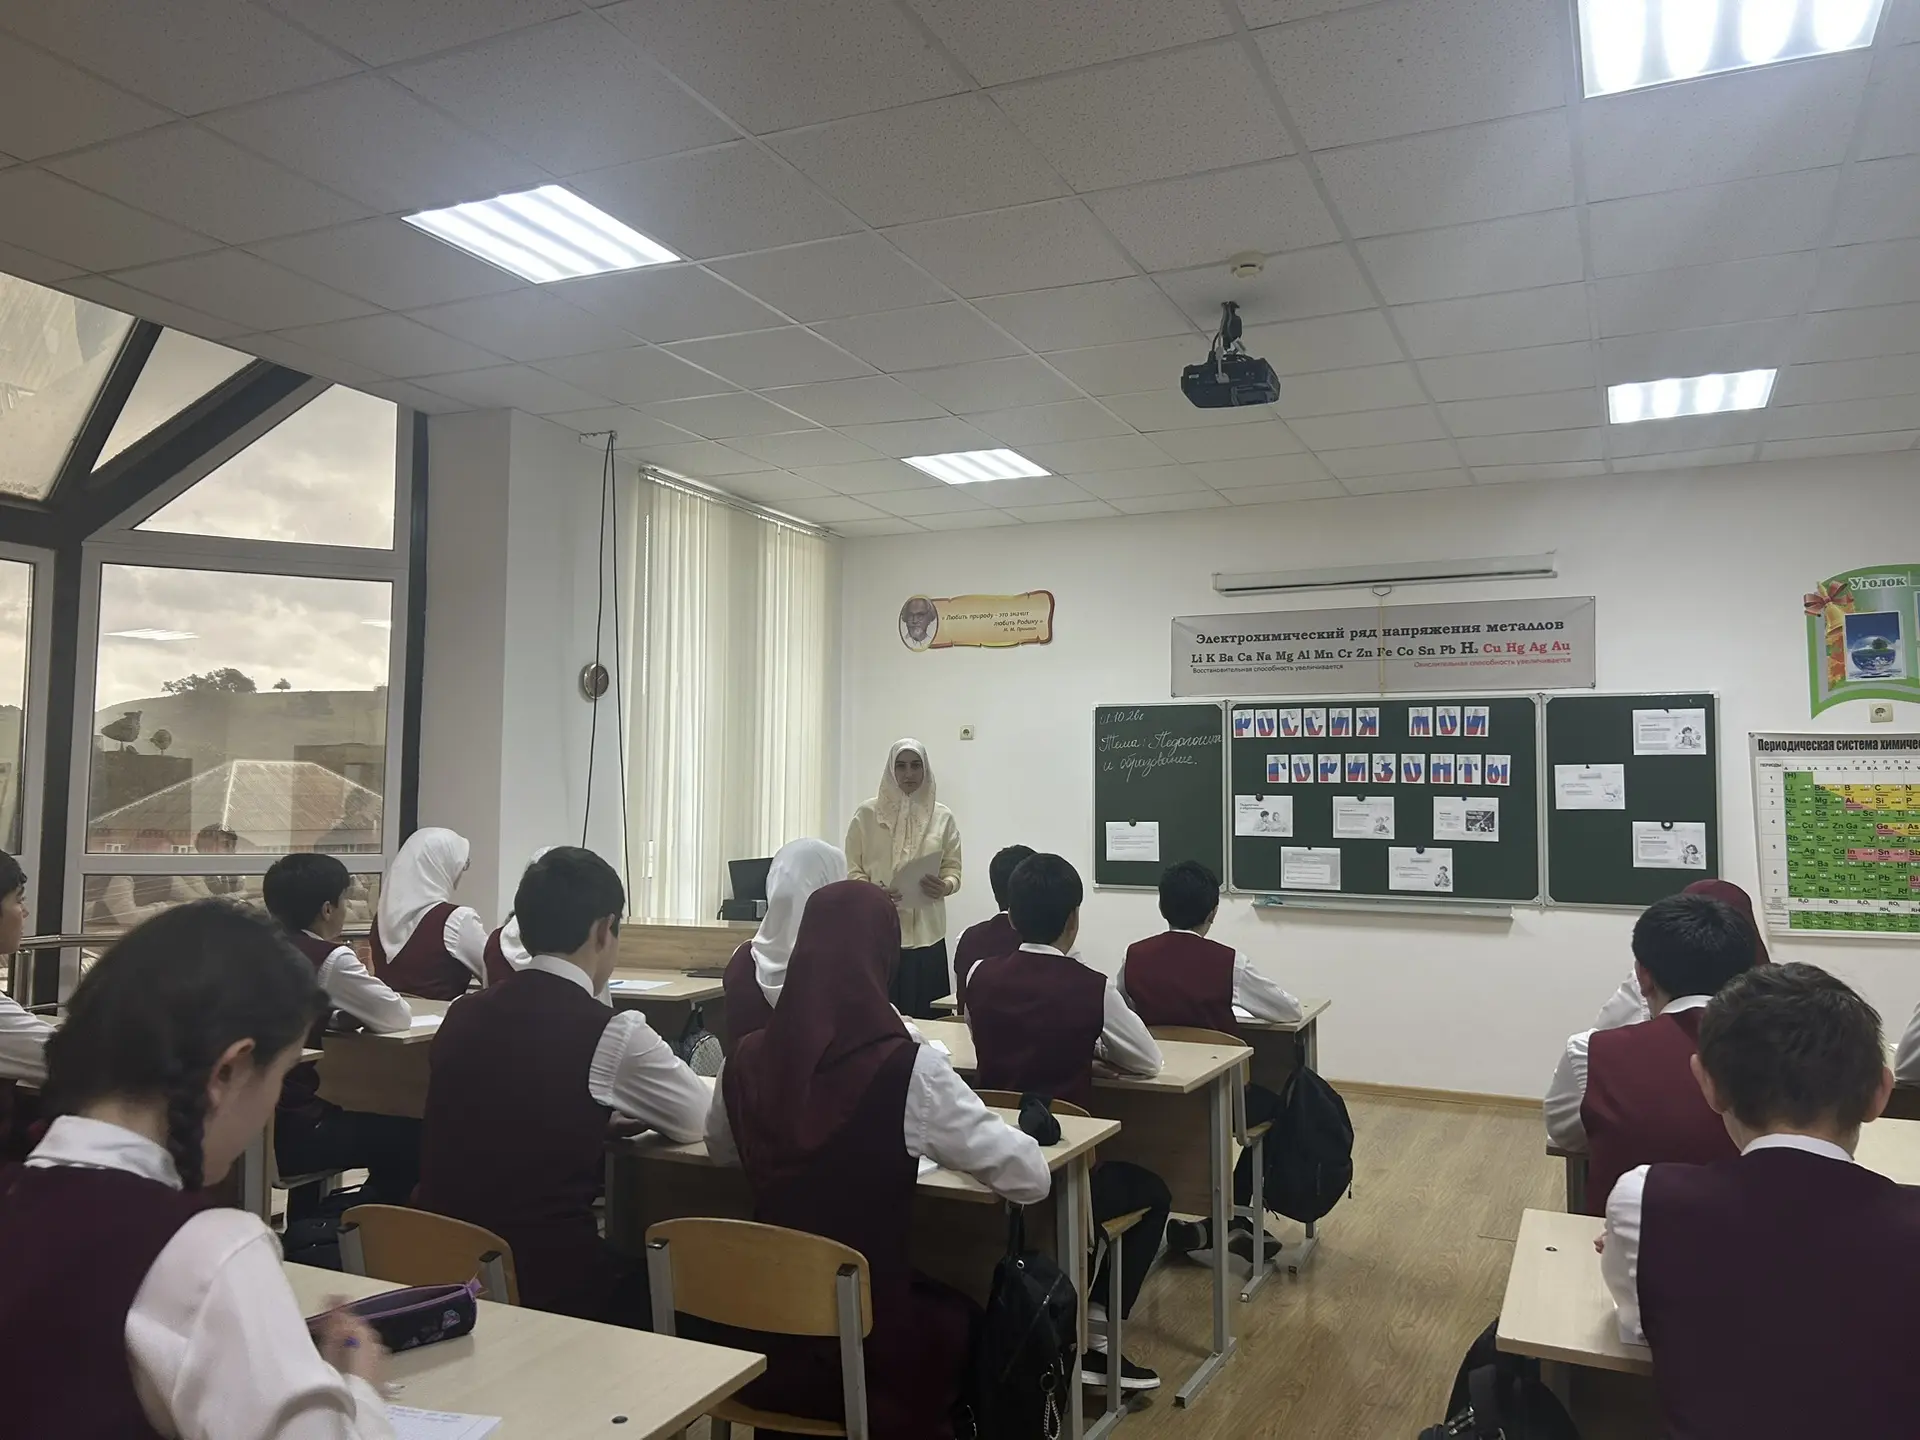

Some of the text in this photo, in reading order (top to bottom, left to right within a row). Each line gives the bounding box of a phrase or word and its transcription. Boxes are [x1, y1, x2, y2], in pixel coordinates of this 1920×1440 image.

[1849, 577, 1906, 591] Уголок
[969, 612, 994, 620] природу
[993, 619, 1015, 627] любить
[1016, 618, 1039, 626] Родину
[1196, 620, 1565, 645] Электрохимический ряд напряжения металлов
[1191, 653, 1203, 664] Li
[1206, 653, 1216, 663] K
[1219, 653, 1234, 662] Ba
[1237, 652, 1253, 662] Ca
[1256, 651, 1272, 661] Na
[1276, 650, 1294, 663] Mg
[1297, 649, 1311, 660] Al
[1314, 649, 1334, 660] Mn
[1337, 648, 1353, 659] Cr
[1356, 648, 1373, 658] Zn
[1377, 647, 1393, 657] Fe
[1397, 646, 1414, 656] Co
[1418, 645, 1436, 655] Sn
[1440, 644, 1457, 655] Pb
[1483, 643, 1501, 653] Cu
[1506, 642, 1525, 655] Hg
[1530, 641, 1548, 654] Ag
[1552, 640, 1571, 651] Au
[1469, 658, 1515, 667] способность
[1516, 656, 1572, 665] увеличивается
[1253, 665, 1294, 673] способность
[1295, 663, 1344, 672] увеличивается
[1234, 707, 1487, 737] РОССИЯ МОИ
[1757, 739, 1835, 752] Периодическая
[1836, 739, 1879, 750] система
[1103, 761, 1114, 772] и
[1267, 755, 1508, 784] ГОРИЗОНТЫ
[1784, 771, 1797, 780] (H)
[1785, 796, 1797, 804] Na
[1814, 796, 1828, 805] Mg
[1814, 809, 1827, 817] Ca
[1845, 822, 1858, 830] Ga
[1804, 847, 1815, 855] Ag
[1834, 873, 1846, 881] Hg
